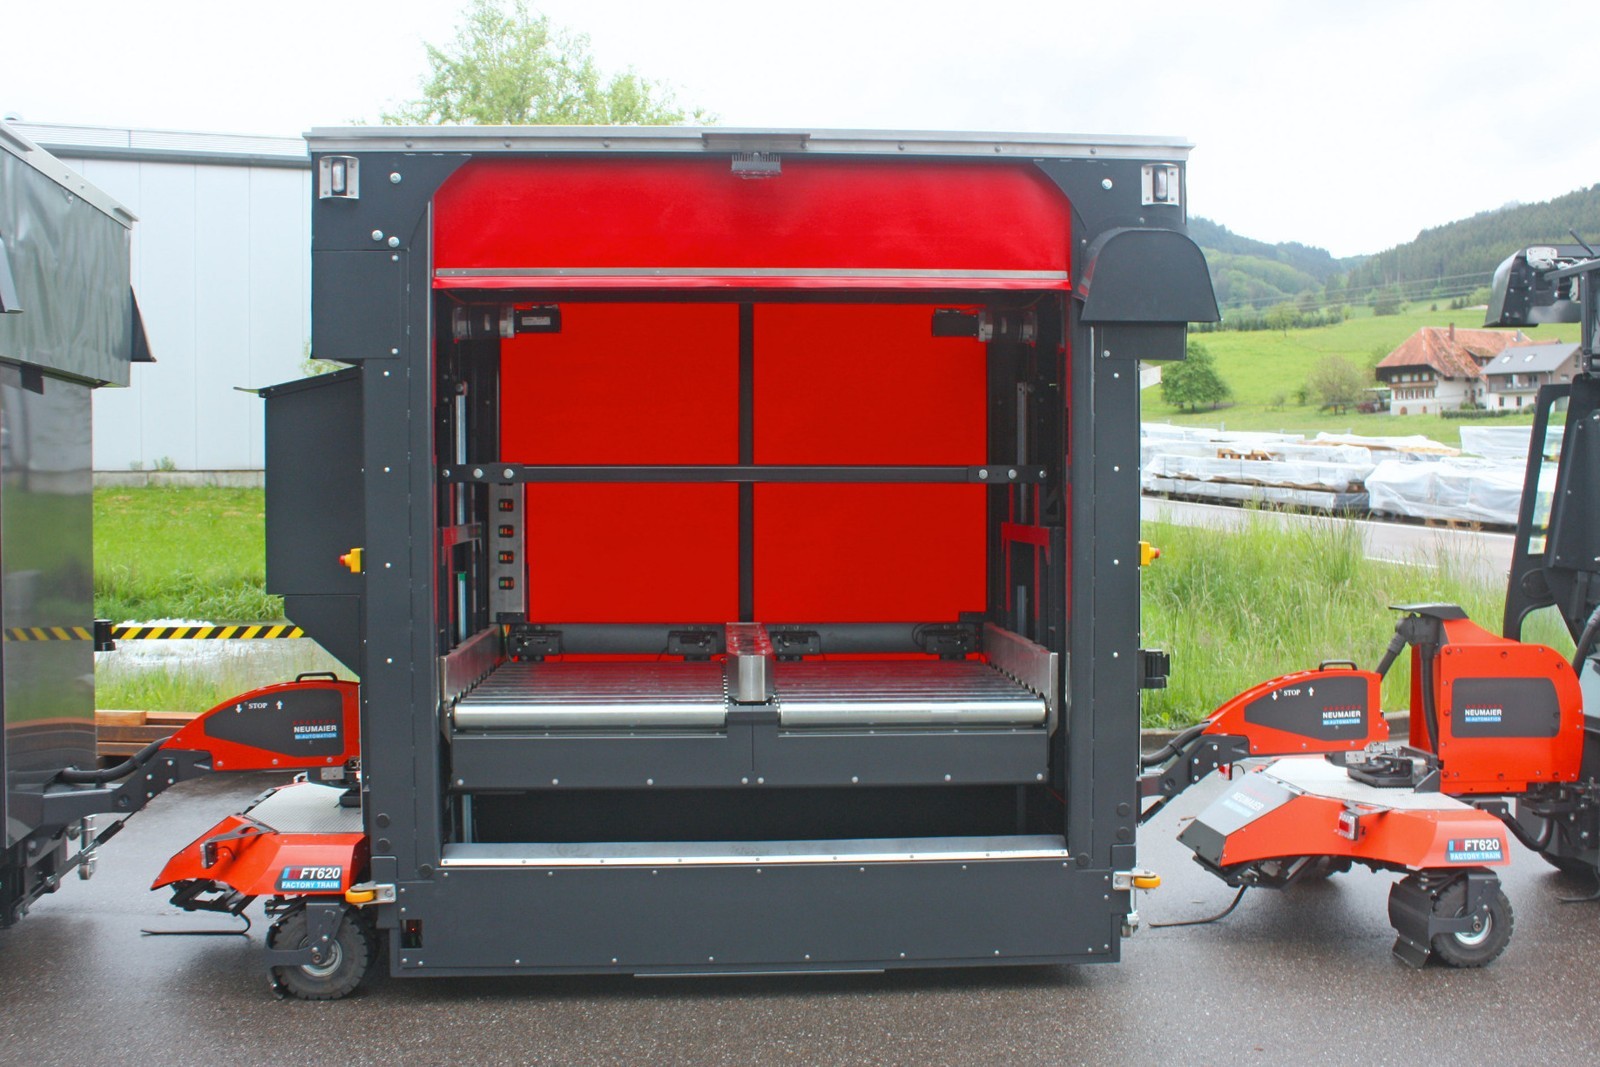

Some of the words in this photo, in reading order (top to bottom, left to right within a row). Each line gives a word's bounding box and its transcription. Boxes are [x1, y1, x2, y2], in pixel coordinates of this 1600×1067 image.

[1283, 688, 1301, 697] STOP
[248, 702, 268, 710] STOP
[1322, 710, 1361, 719] NEUMAIER
[1464, 708, 1502, 716] NEUMAIER
[293, 725, 337, 733] NEUMAIER
[1464, 838, 1500, 851] FT620
[1449, 851, 1480, 861] FACTORY
[1480, 850, 1502, 860] TRAIN
[299, 867, 341, 879] FT620
[281, 880, 315, 889] FACTORY
[317, 880, 339, 889] TRAIN
